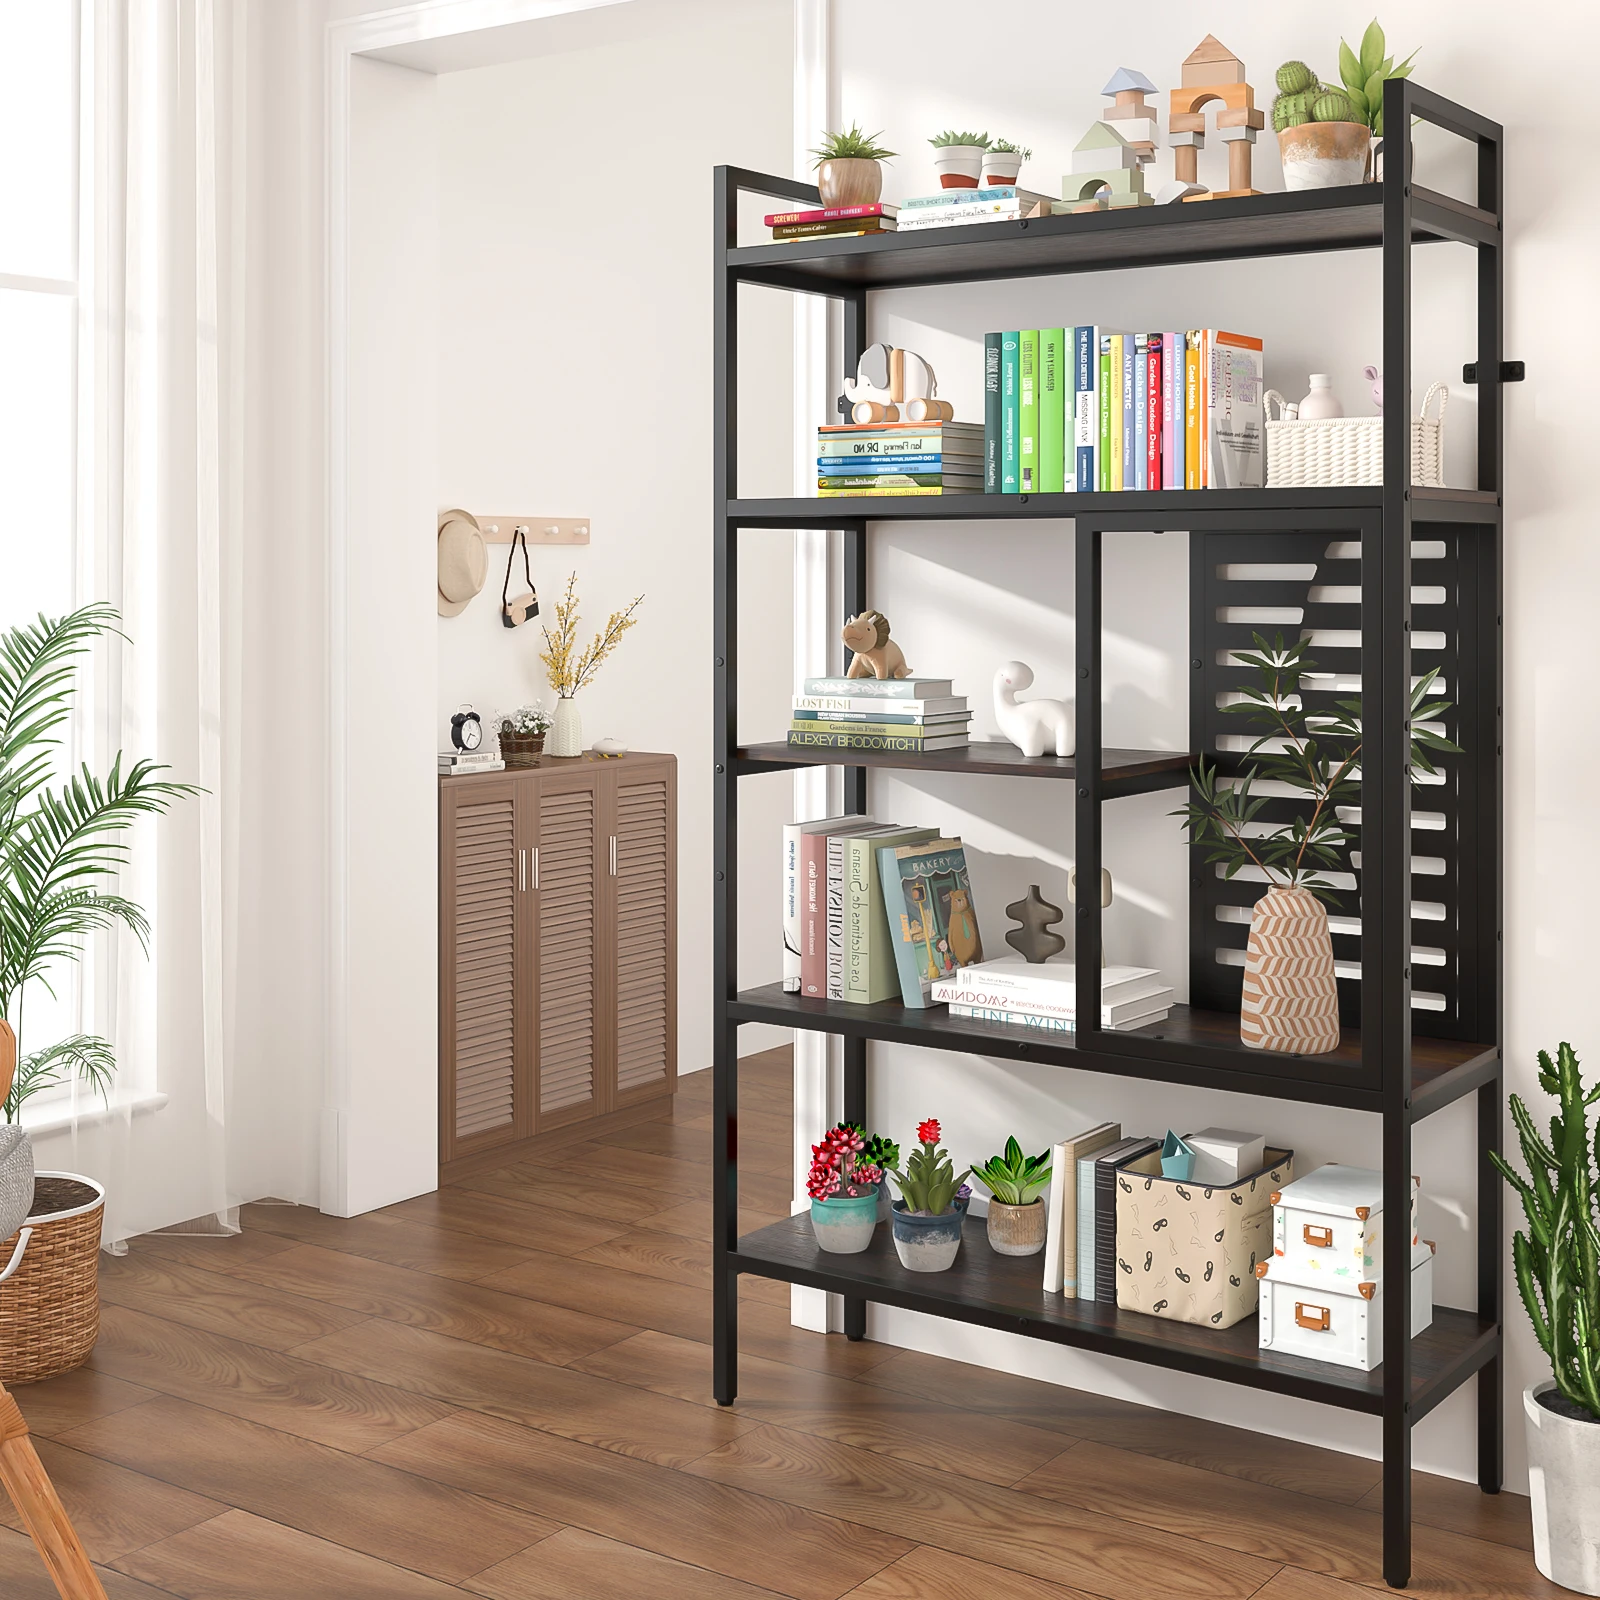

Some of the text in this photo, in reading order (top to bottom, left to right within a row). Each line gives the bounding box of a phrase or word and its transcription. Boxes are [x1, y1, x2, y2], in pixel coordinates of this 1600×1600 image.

[773, 214, 800, 224] SCREWED!
[1136, 402, 1144, 435] Design
[1148, 434, 1156, 460] Design
[796, 698, 851, 710] LOST FISH
[830, 724, 856, 732] Gardens
[790, 733, 914, 750] ALEXEY BRODOVITCH
[912, 857, 952, 872] BAKERY
[971, 1008, 1014, 1024] FINE
